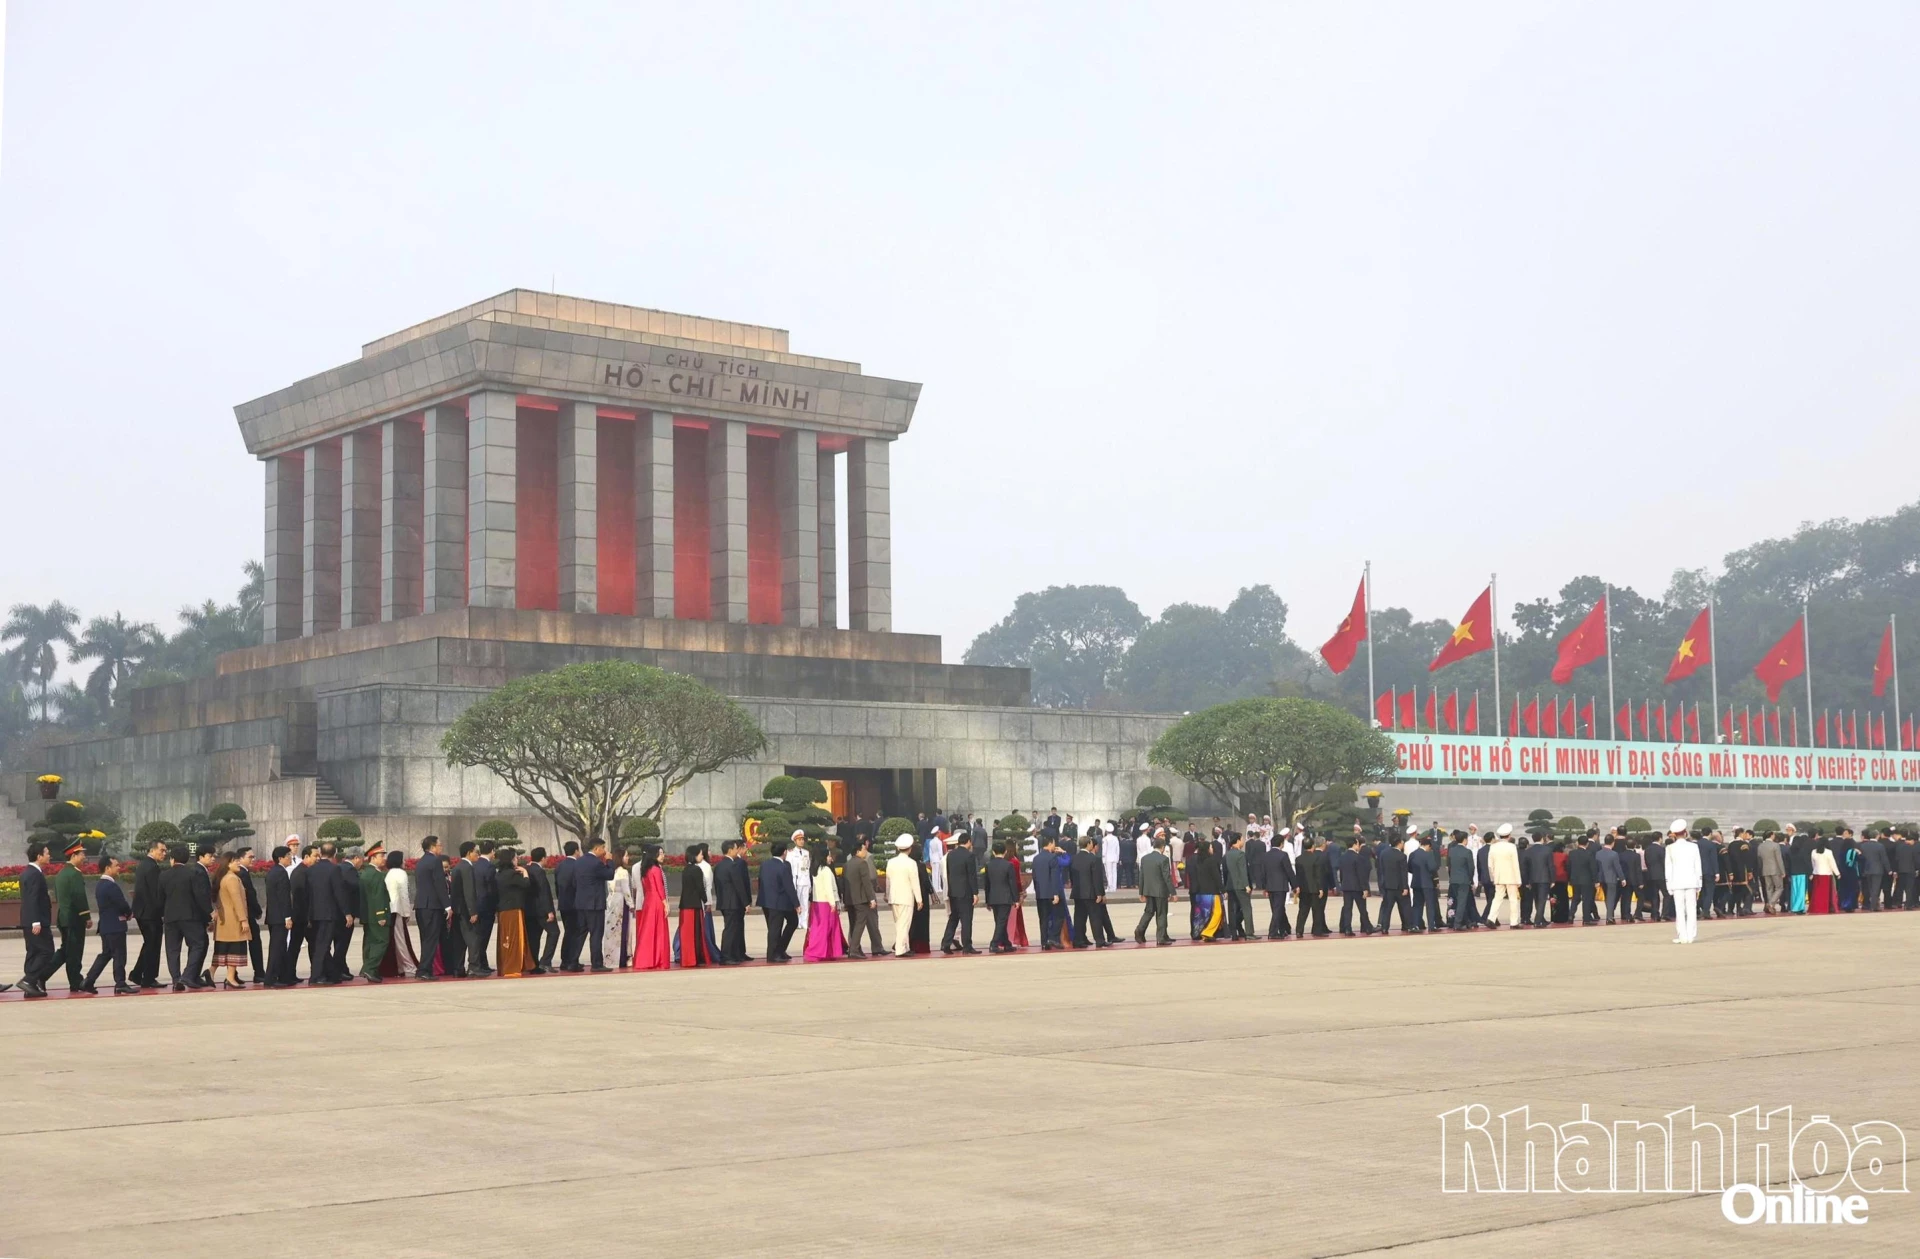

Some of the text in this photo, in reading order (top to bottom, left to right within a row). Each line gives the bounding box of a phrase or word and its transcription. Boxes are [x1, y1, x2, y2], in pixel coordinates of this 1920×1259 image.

[604, 362, 646, 388] HỒ
[1396, 735, 1920, 784] CHỦ TỊCH HỒ CHÍ MINH VĨ ĐẠI SỐNG MÃI TRONG SỰ NGHIỆP CỦA CH
